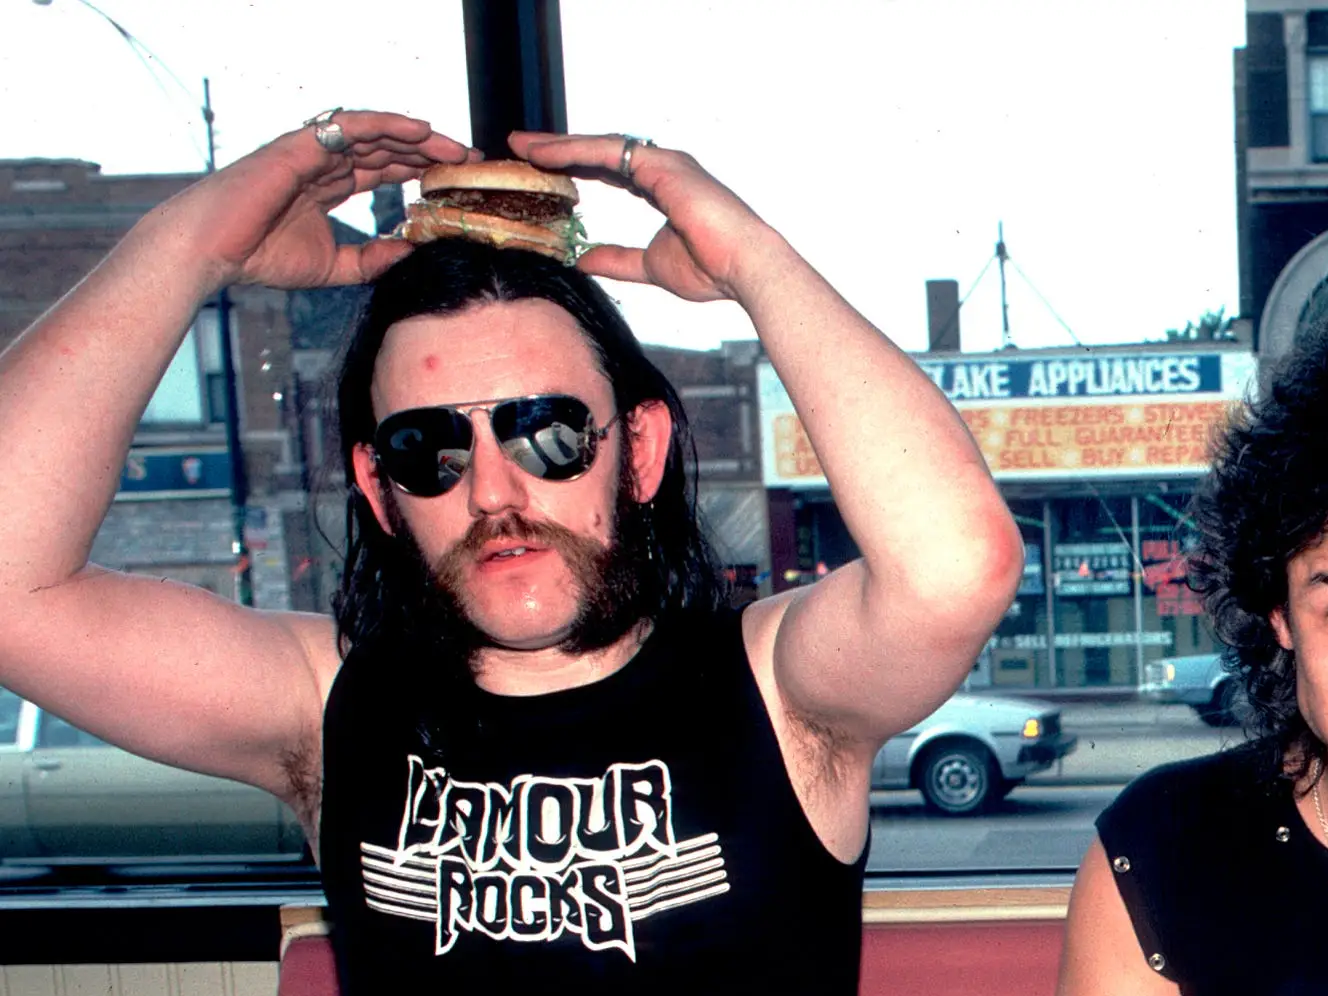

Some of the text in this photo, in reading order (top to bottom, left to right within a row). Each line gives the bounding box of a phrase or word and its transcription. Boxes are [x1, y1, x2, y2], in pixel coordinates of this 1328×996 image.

[922, 357, 1200, 398] LAKE APPLIANCES
[1009, 404, 1125, 427] FREEZERS
[1143, 402, 1226, 424] STOVES
[1004, 429, 1062, 448] FULL
[999, 444, 1210, 469] SELL BUY REPA
[435, 855, 637, 963] ROCKS
